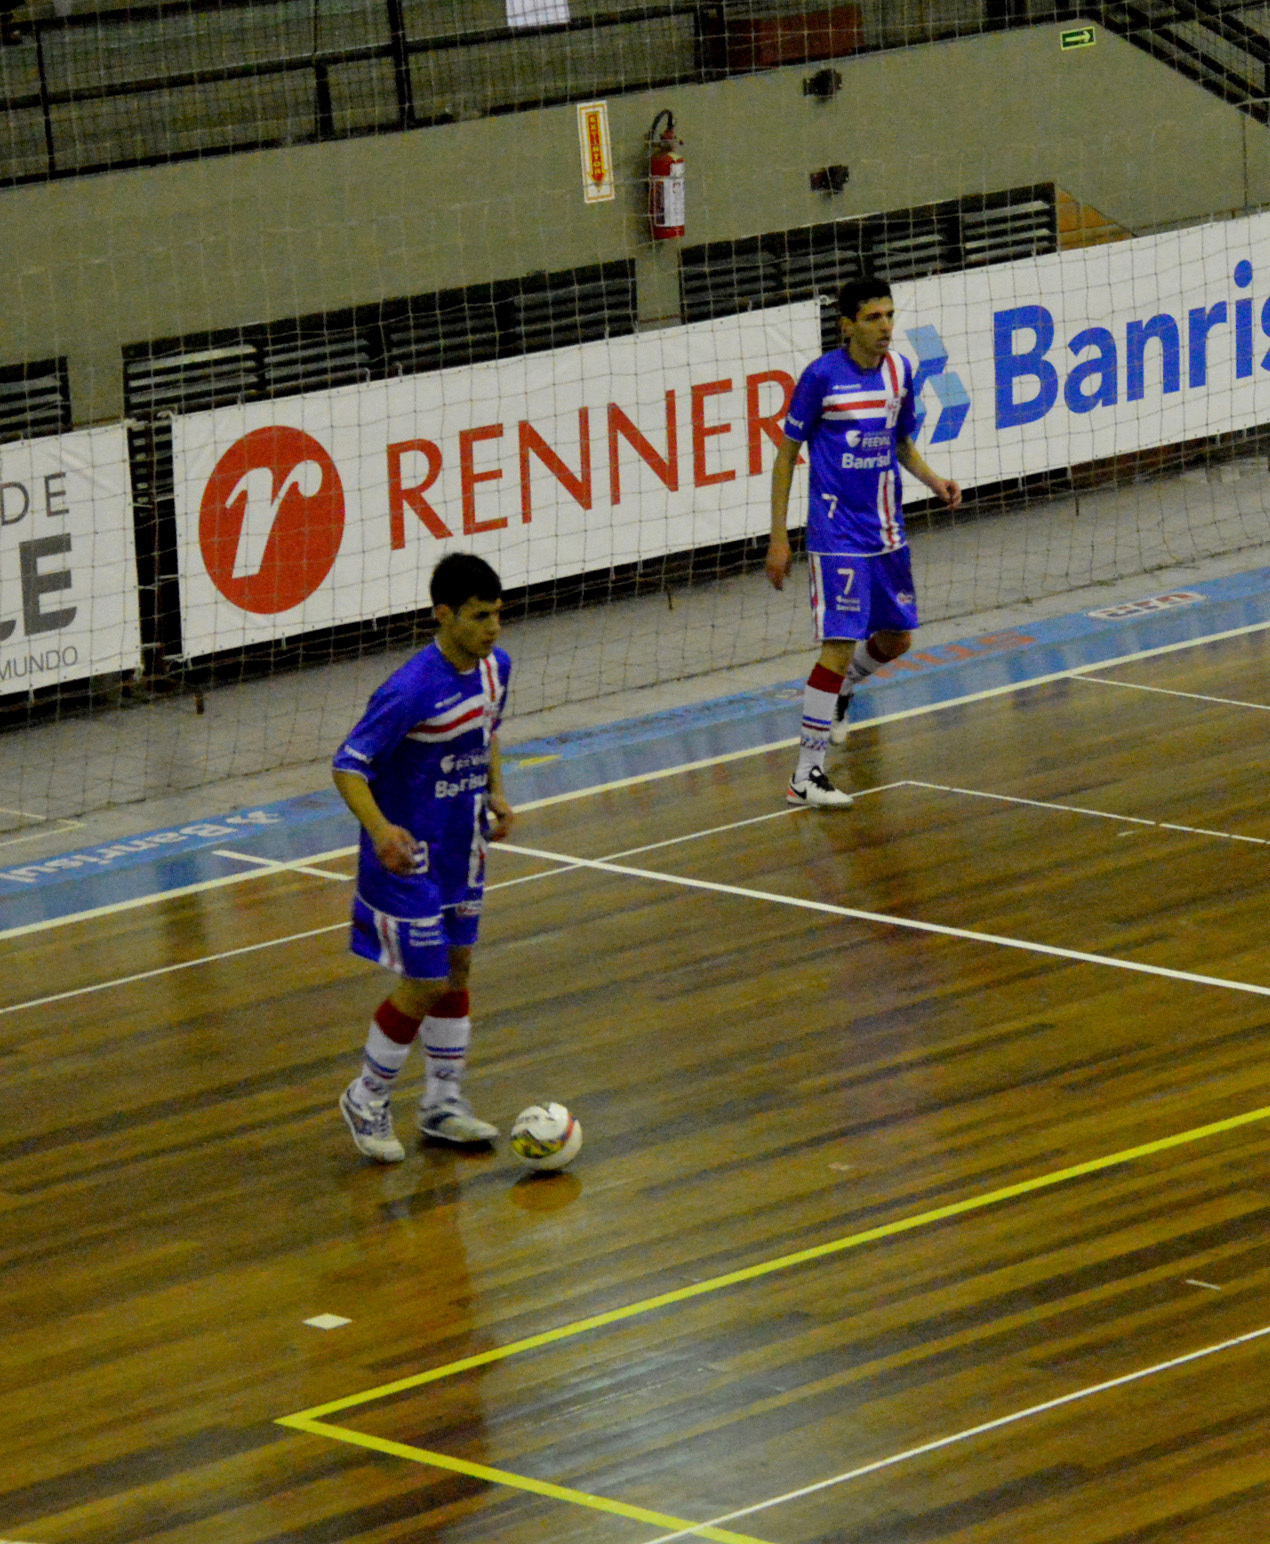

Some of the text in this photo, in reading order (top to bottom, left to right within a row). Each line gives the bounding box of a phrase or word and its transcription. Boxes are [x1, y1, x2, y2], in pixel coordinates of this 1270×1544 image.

[387, 369, 806, 551] RENNER
[821, 493, 838, 518] 7
[0, 533, 77, 642] E
[837, 568, 854, 595] 7
